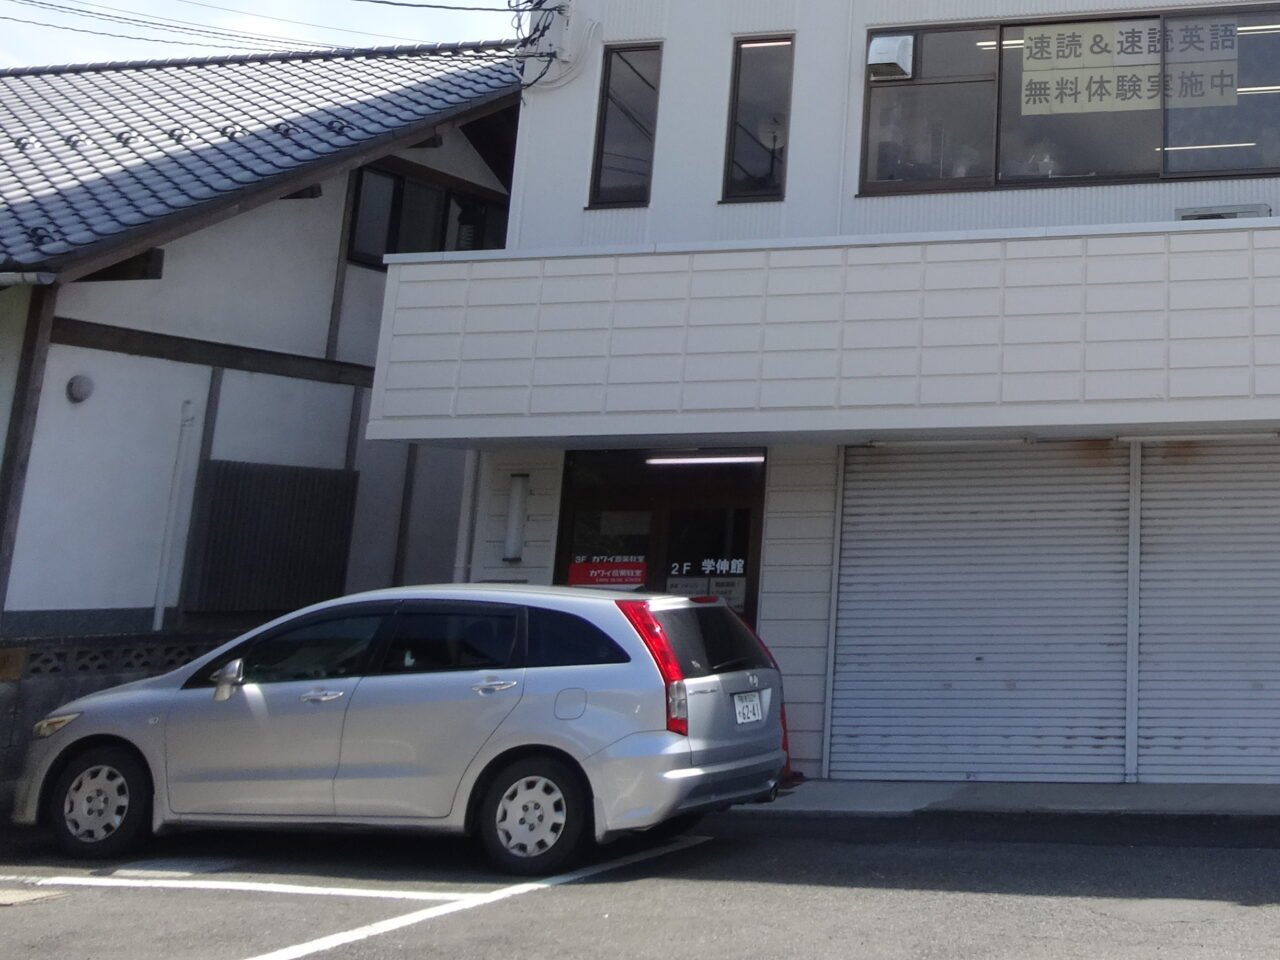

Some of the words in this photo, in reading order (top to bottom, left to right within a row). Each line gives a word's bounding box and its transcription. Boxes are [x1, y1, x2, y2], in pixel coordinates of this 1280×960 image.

[1026, 23, 1236, 61] 速読&速読英語
[1024, 70, 1235, 105] 無料体験実施中
[671, 562, 691, 575] 2F
[702, 559, 744, 575] 学伸館
